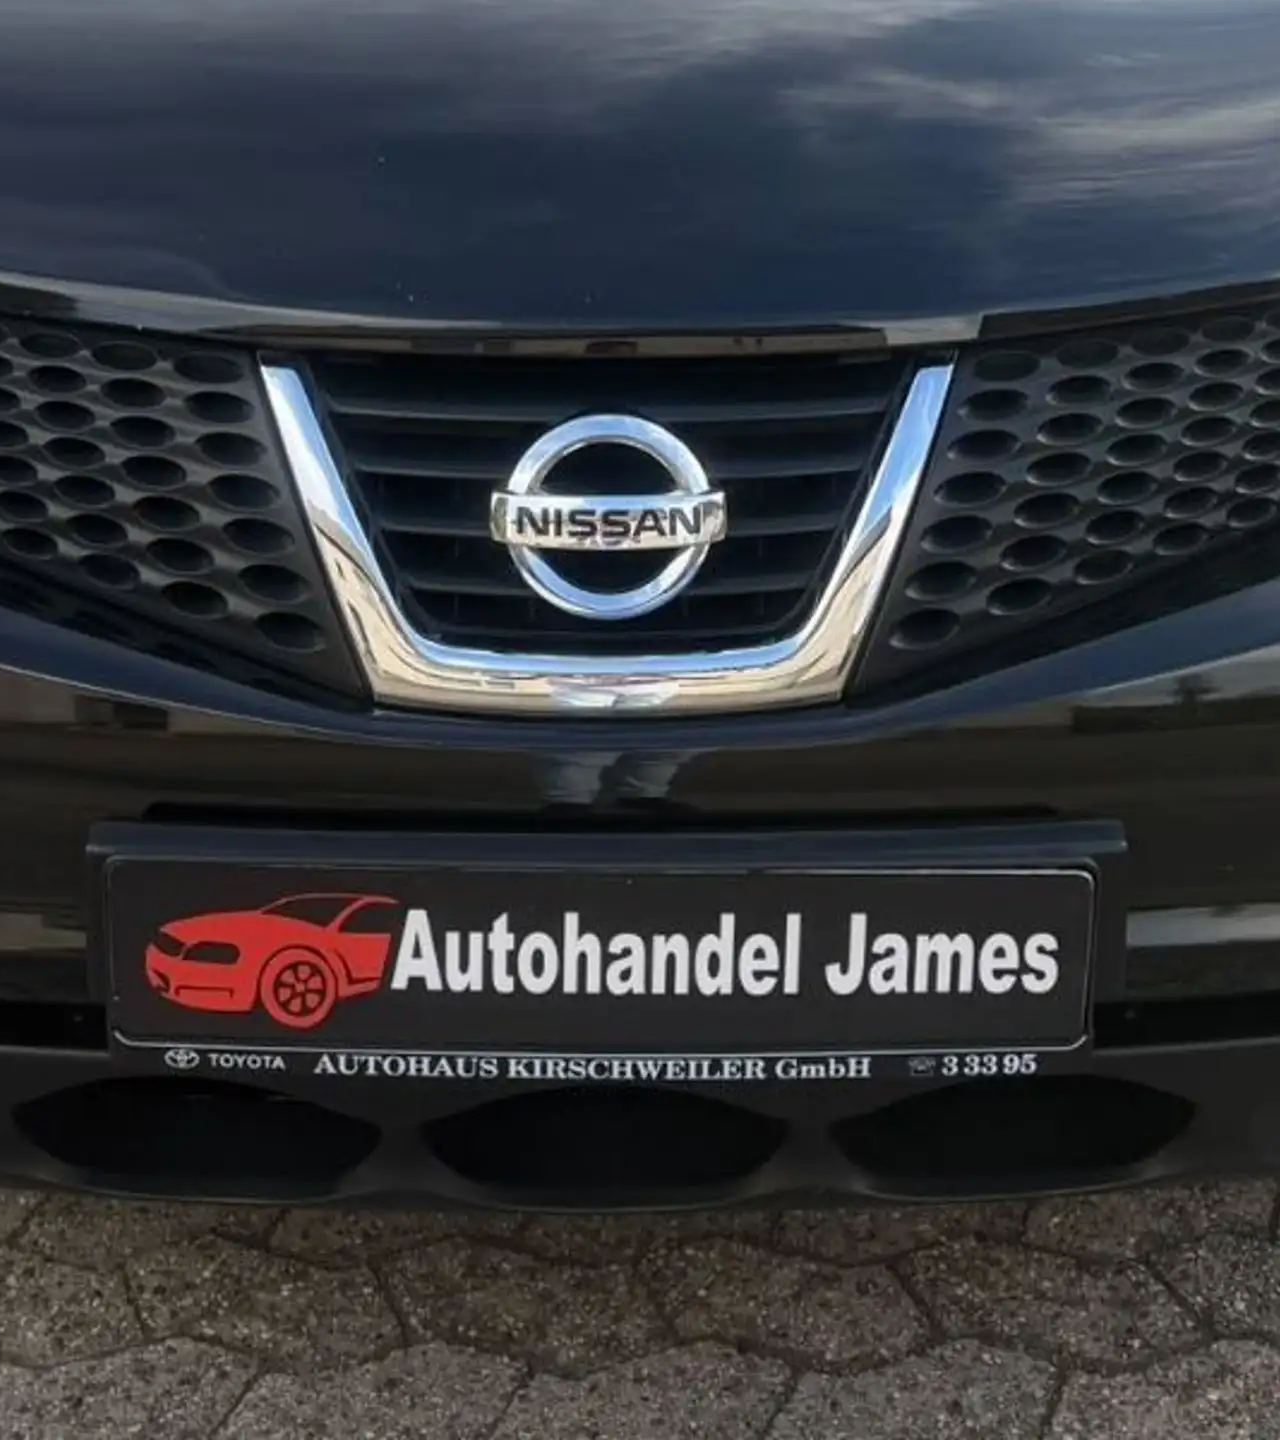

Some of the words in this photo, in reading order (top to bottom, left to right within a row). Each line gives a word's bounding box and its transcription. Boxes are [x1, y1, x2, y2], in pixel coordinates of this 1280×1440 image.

[515, 504, 702, 538] NISSAN
[391, 908, 802, 997] Autohandel
[824, 912, 1060, 996] James
[208, 1053, 286, 1070] TOYOTA
[313, 1053, 499, 1079] AUTOHAUS
[506, 1055, 767, 1080] KIRSCHWEILER
[774, 1057, 872, 1080] GmbH
